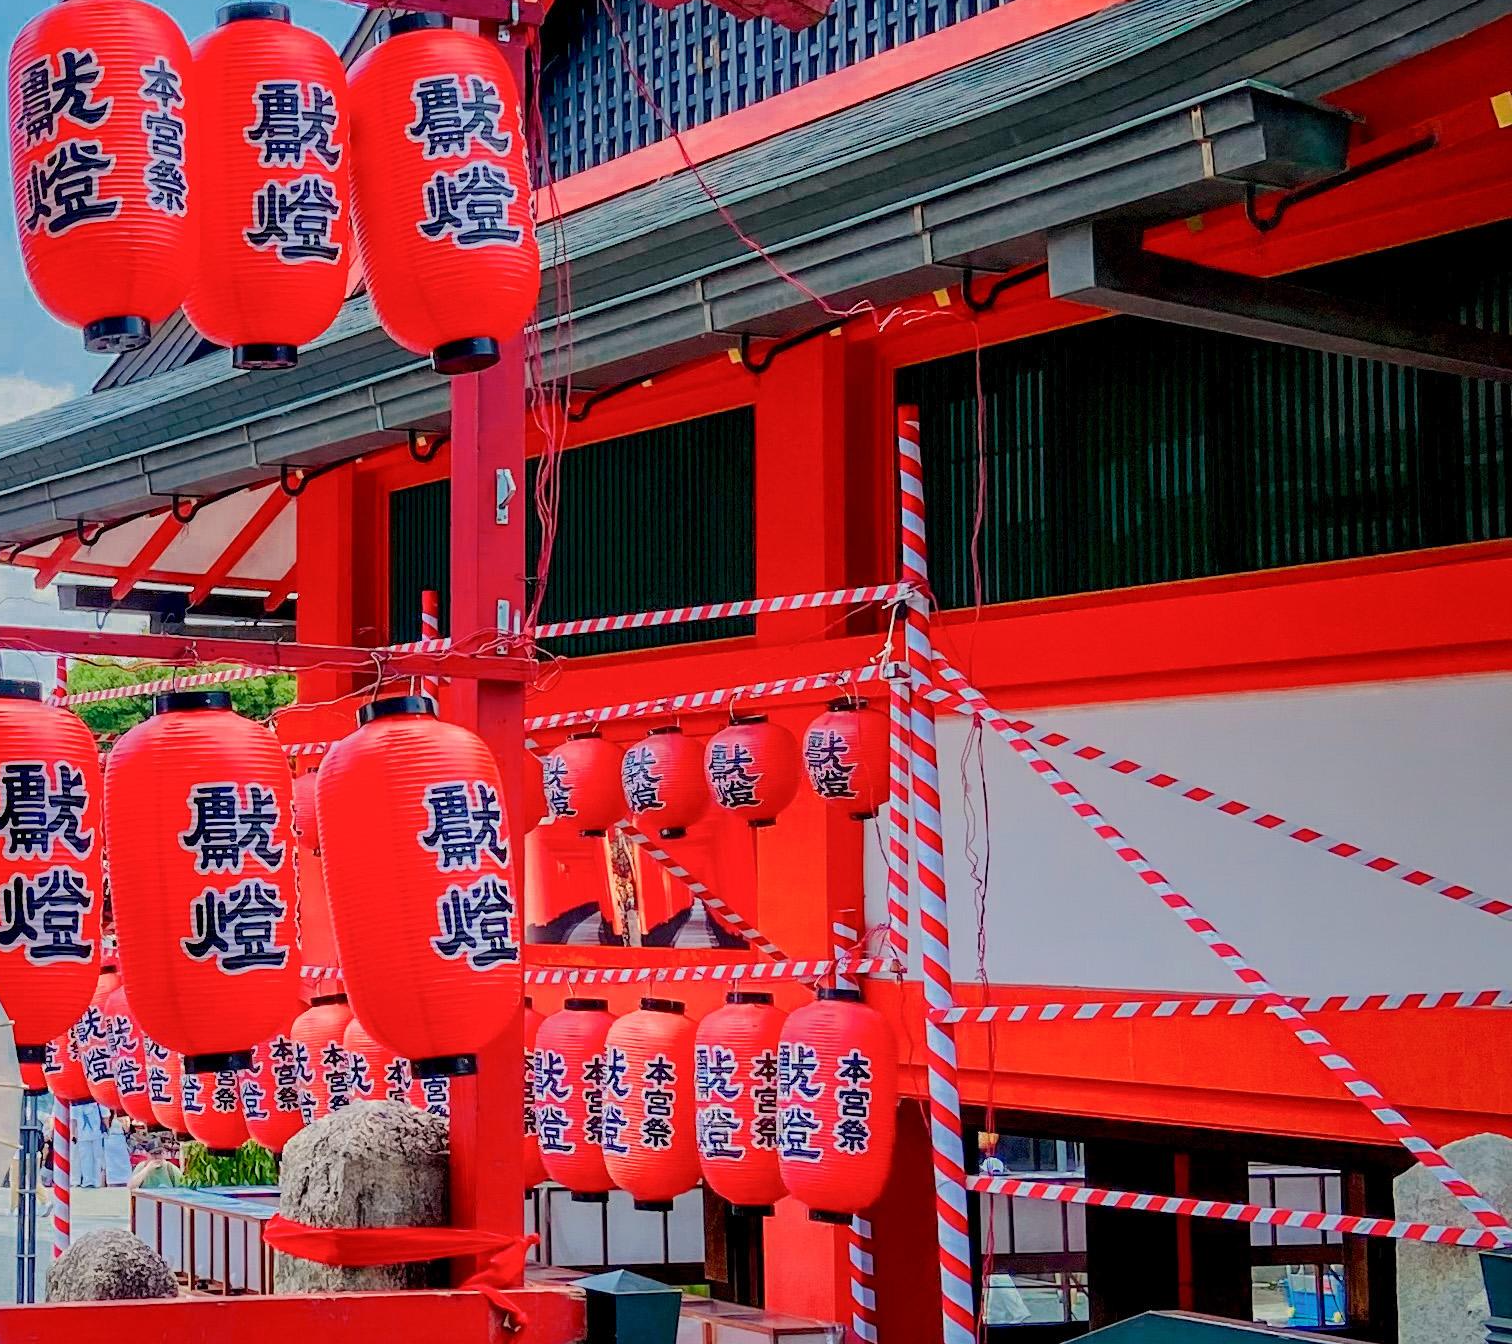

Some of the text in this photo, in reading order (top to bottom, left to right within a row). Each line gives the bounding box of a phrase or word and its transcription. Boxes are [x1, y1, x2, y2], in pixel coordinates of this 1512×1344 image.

[142, 59, 188, 212] 本宮祭
[272, 1037, 300, 1111] 本宮祭
[642, 1056, 676, 1148] 本宮祭
[753, 1052, 779, 1148] 本宮祭
[837, 1052, 871, 1152] 本宮祭
